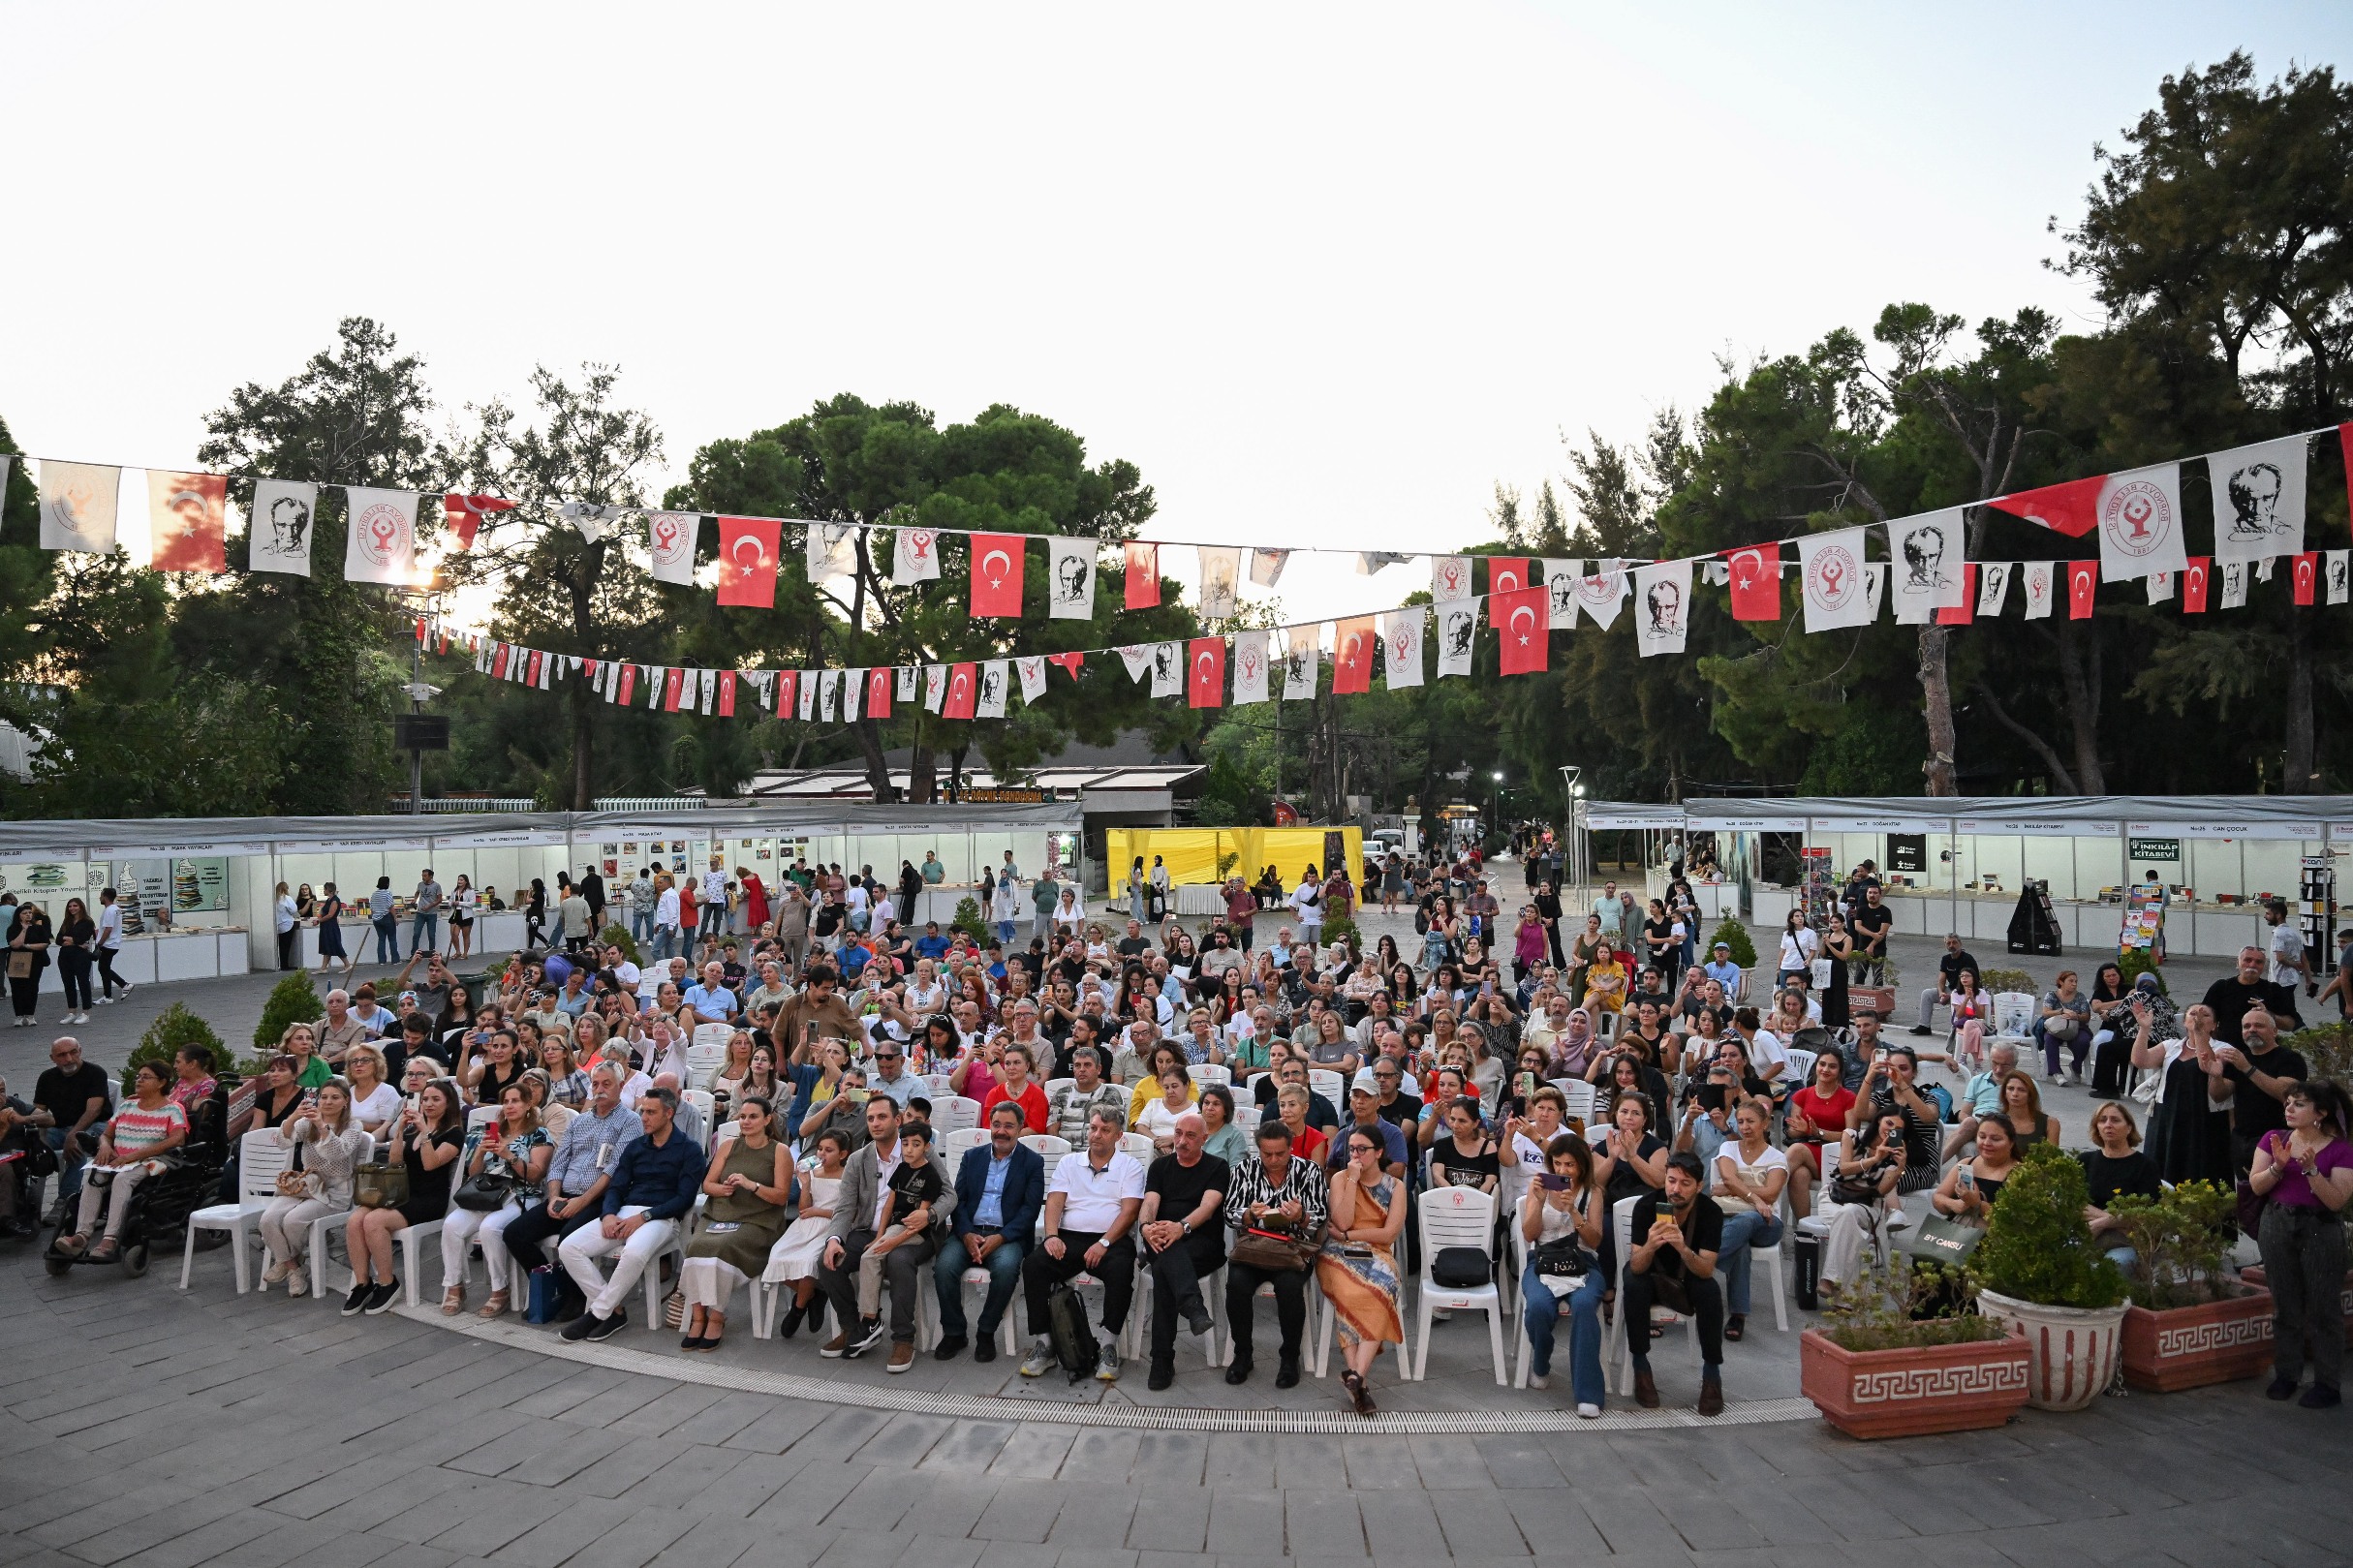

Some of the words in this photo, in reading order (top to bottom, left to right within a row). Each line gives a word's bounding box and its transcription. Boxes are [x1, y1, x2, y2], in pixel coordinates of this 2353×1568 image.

[2134, 848, 2175, 858] KİTABEVİ
[1924, 1233, 1936, 1243] BY
[1935, 1238, 1966, 1250] CANSU
